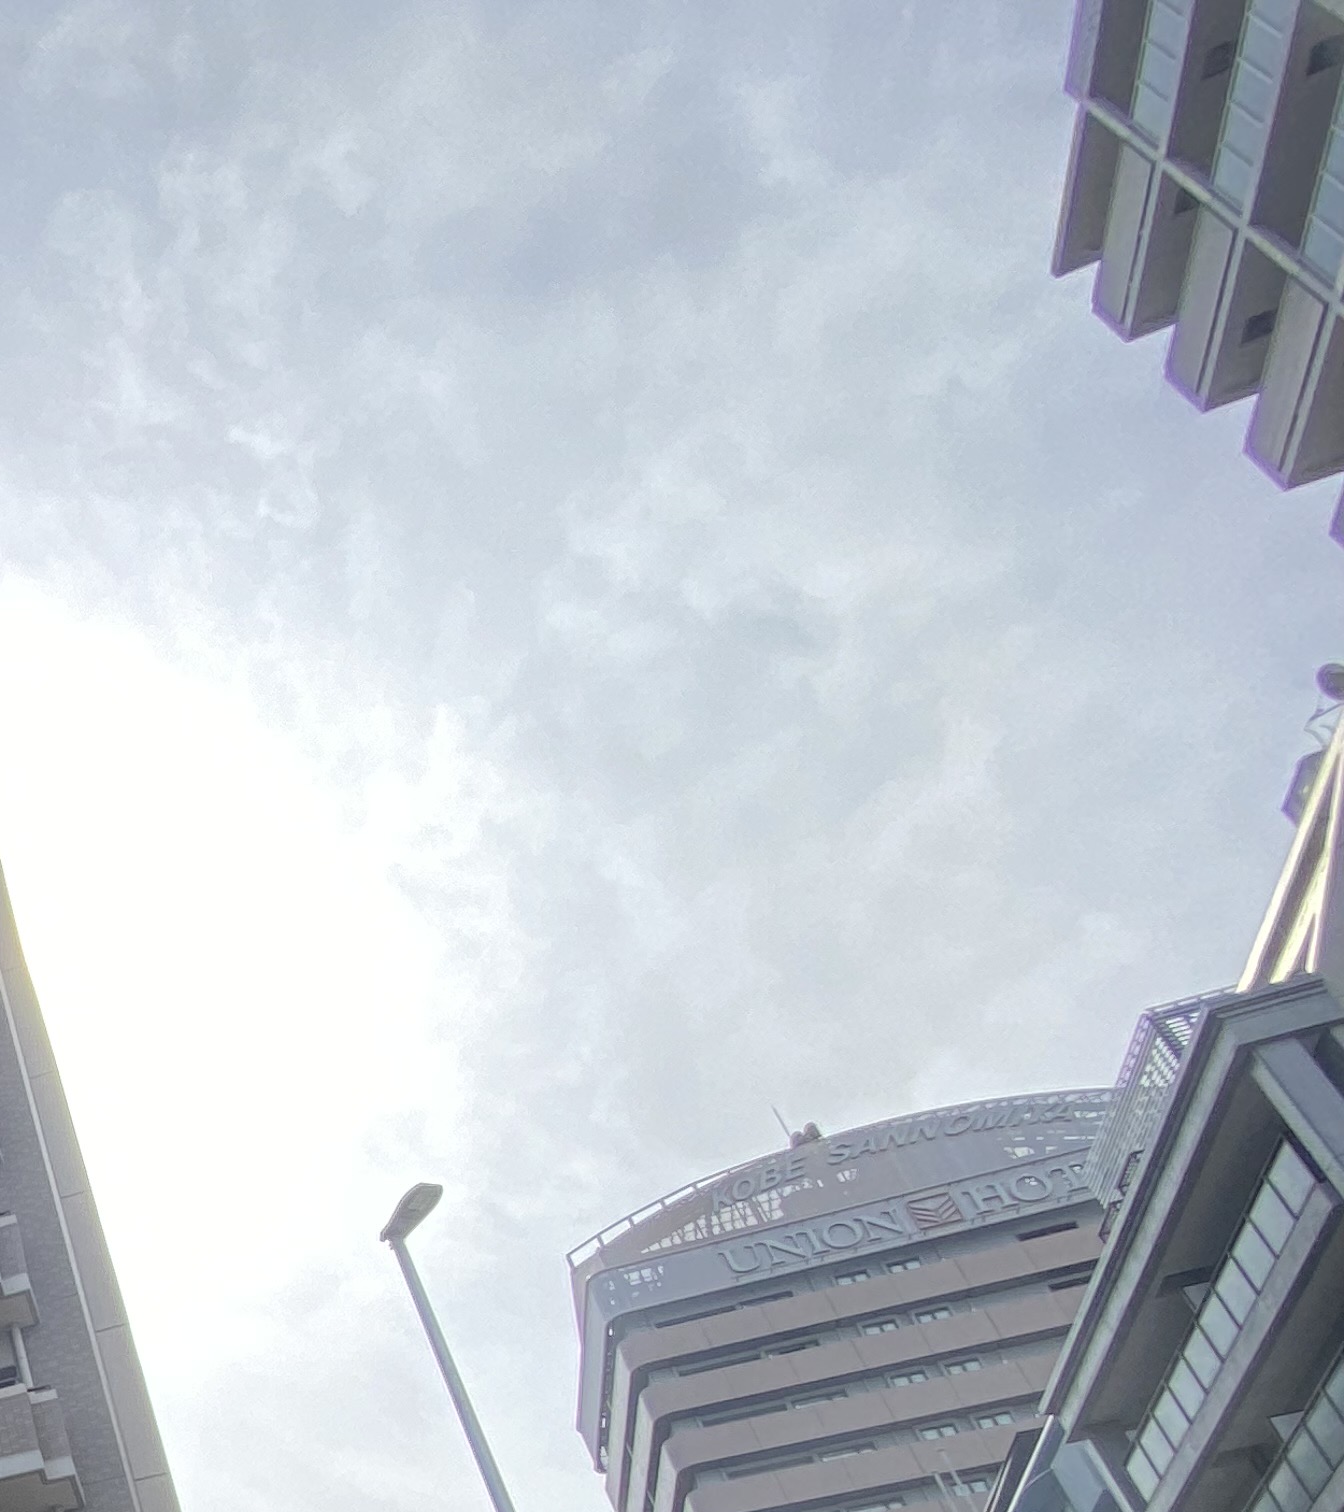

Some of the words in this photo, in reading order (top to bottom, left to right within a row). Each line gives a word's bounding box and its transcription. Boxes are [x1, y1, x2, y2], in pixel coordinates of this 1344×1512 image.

[712, 1153, 807, 1213] KOBE
[827, 1104, 1075, 1165] SANNOMIYA
[718, 1203, 905, 1274] UNION
